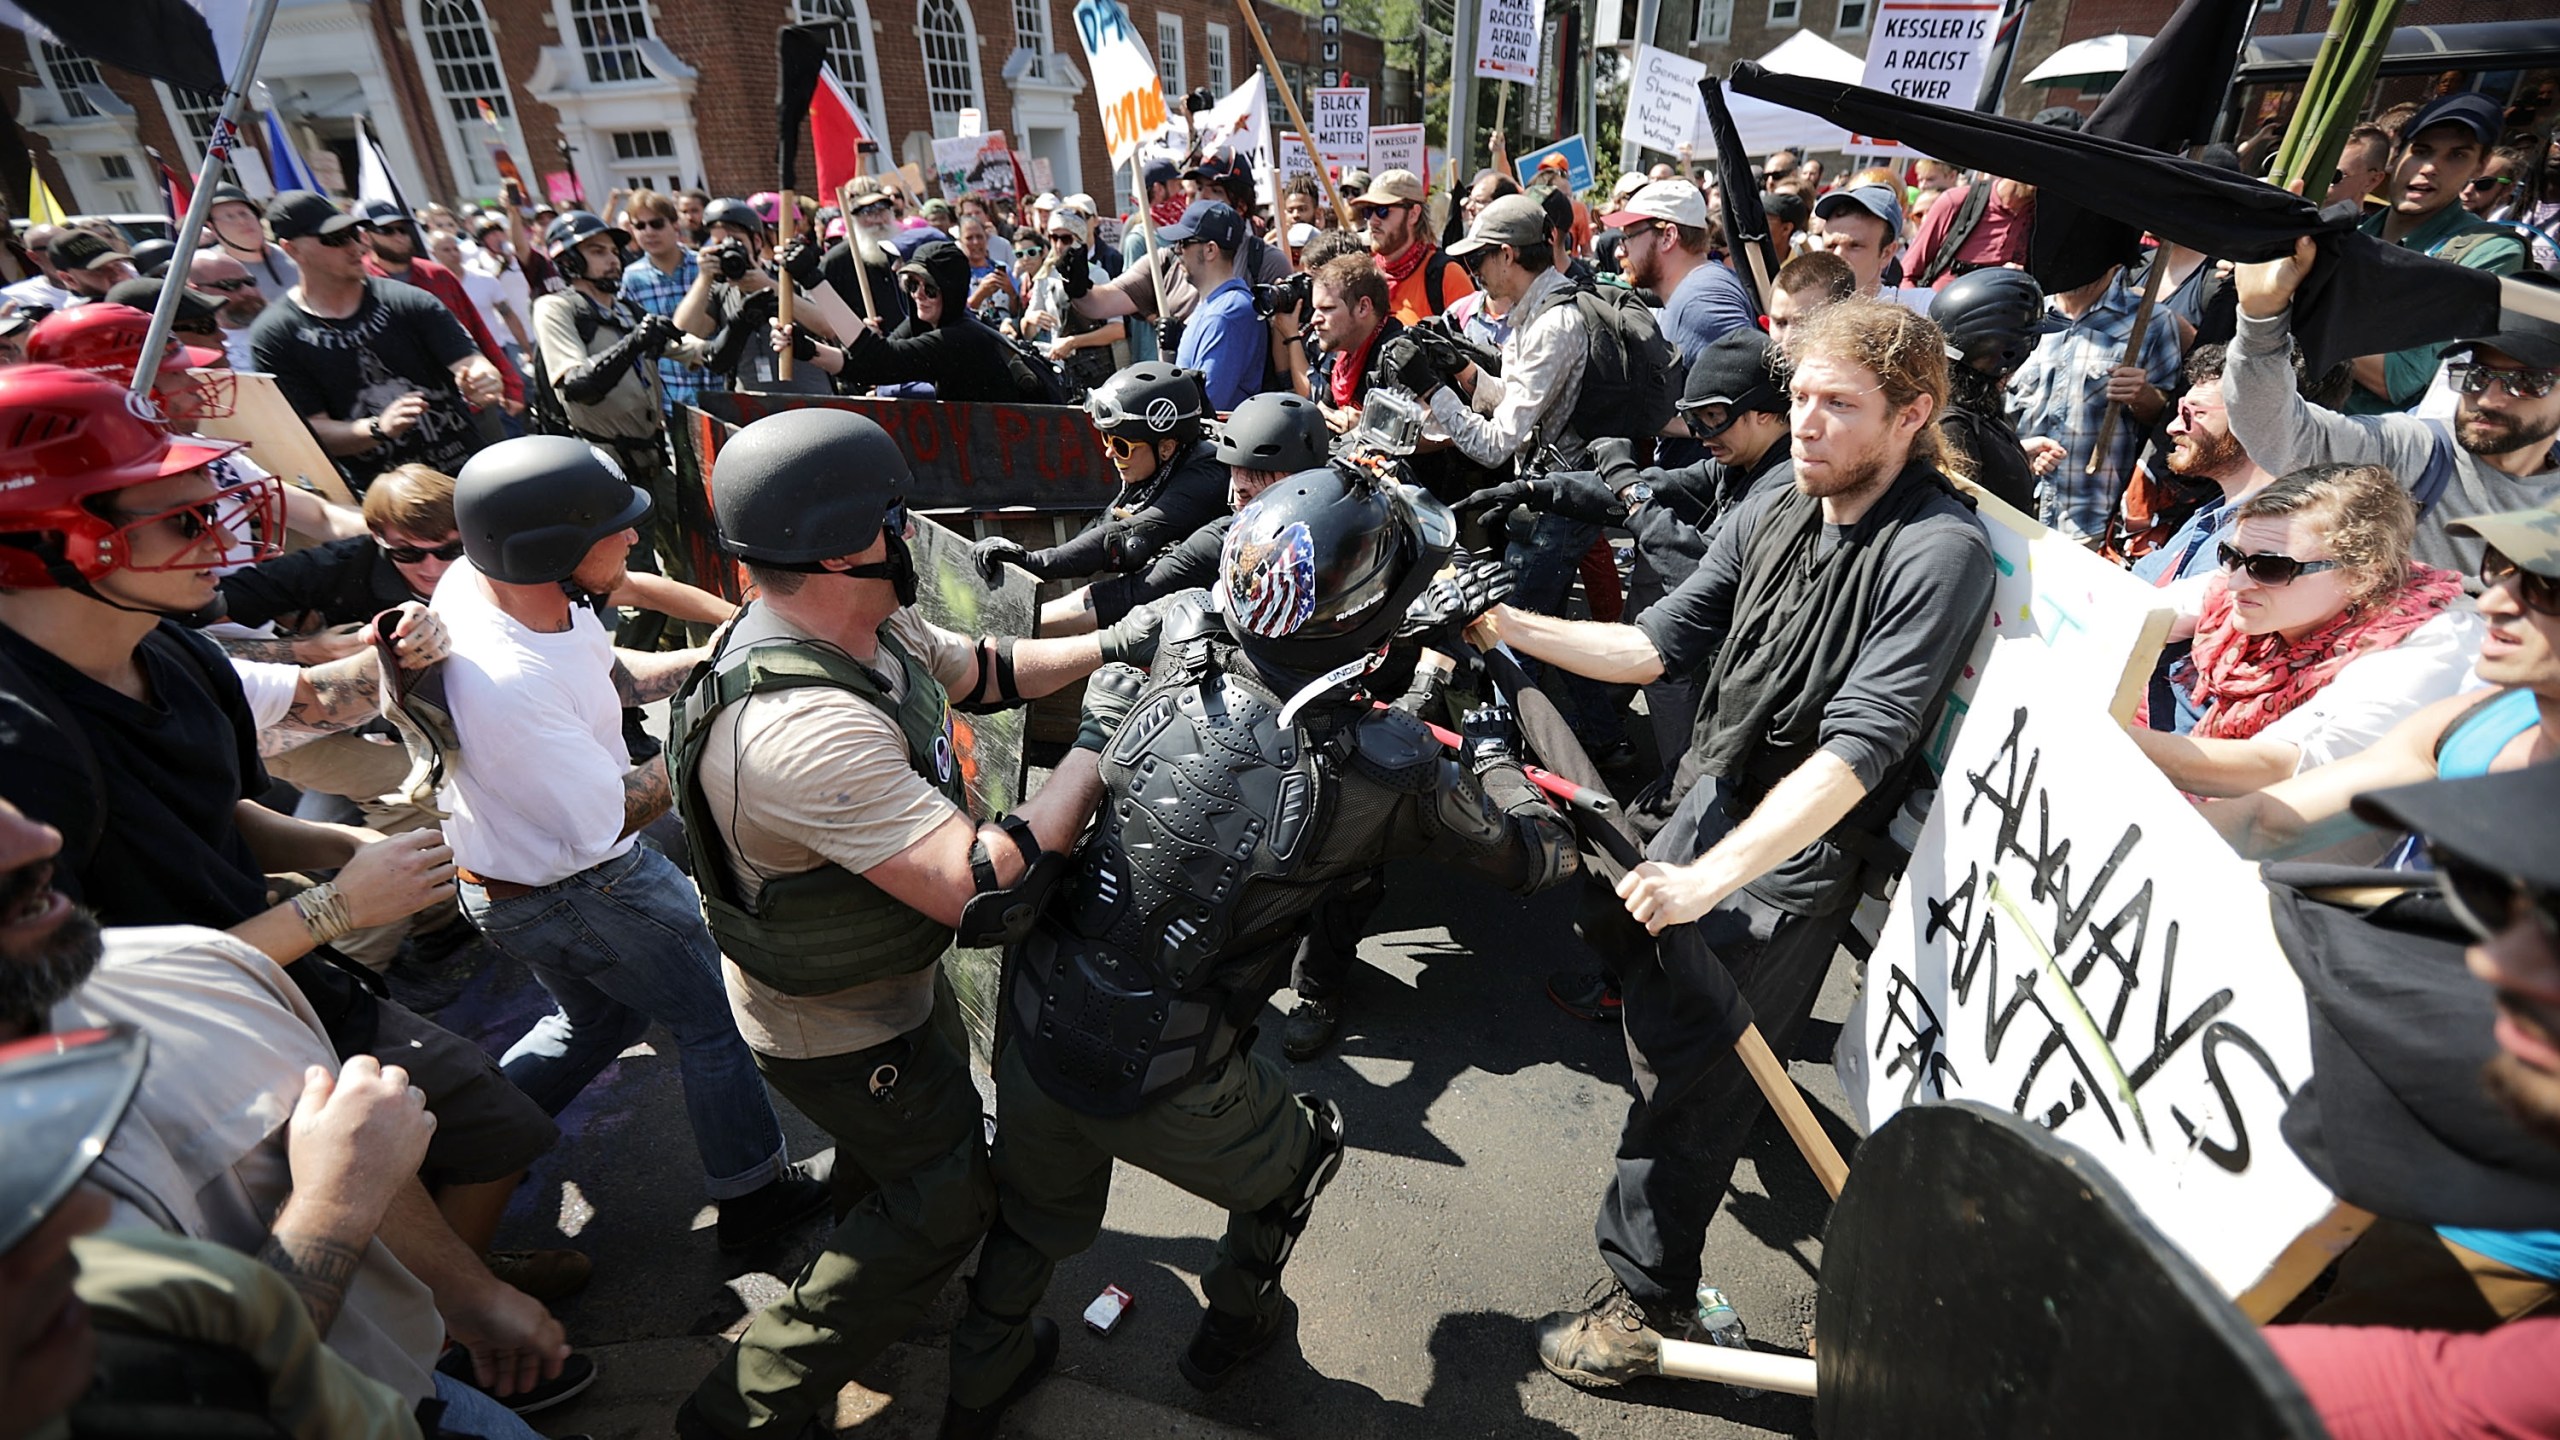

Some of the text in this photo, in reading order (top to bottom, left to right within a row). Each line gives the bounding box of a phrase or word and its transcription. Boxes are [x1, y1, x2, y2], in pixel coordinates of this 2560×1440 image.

[1490, 9, 1536, 30] RACISTS
[1884, 18, 1987, 40] KESSLER IS
[1491, 27, 1532, 47] AFRAID
[1492, 44, 1528, 63] AGAIN
[1884, 50, 1970, 71] A RACIST
[1539, 20, 1558, 135] Downtown Mall
[1649, 57, 1696, 89] General
[1645, 75, 1692, 105] Sherman
[1890, 79, 1951, 99] SEWER
[1320, 95, 1362, 111] BLACK
[1655, 97, 1672, 112] Did
[1323, 113, 1358, 128] LIVES
[1639, 104, 1682, 136] Nothing
[1319, 131, 1364, 145] MATTER
[1374, 135, 1418, 147] KKKESSLER
[1643, 124, 1676, 152] Wrong
[1391, 150, 1410, 159] NAZI
[1327, 663, 1363, 683] UNDER
[1962, 705, 2292, 1174] ALWAYS
